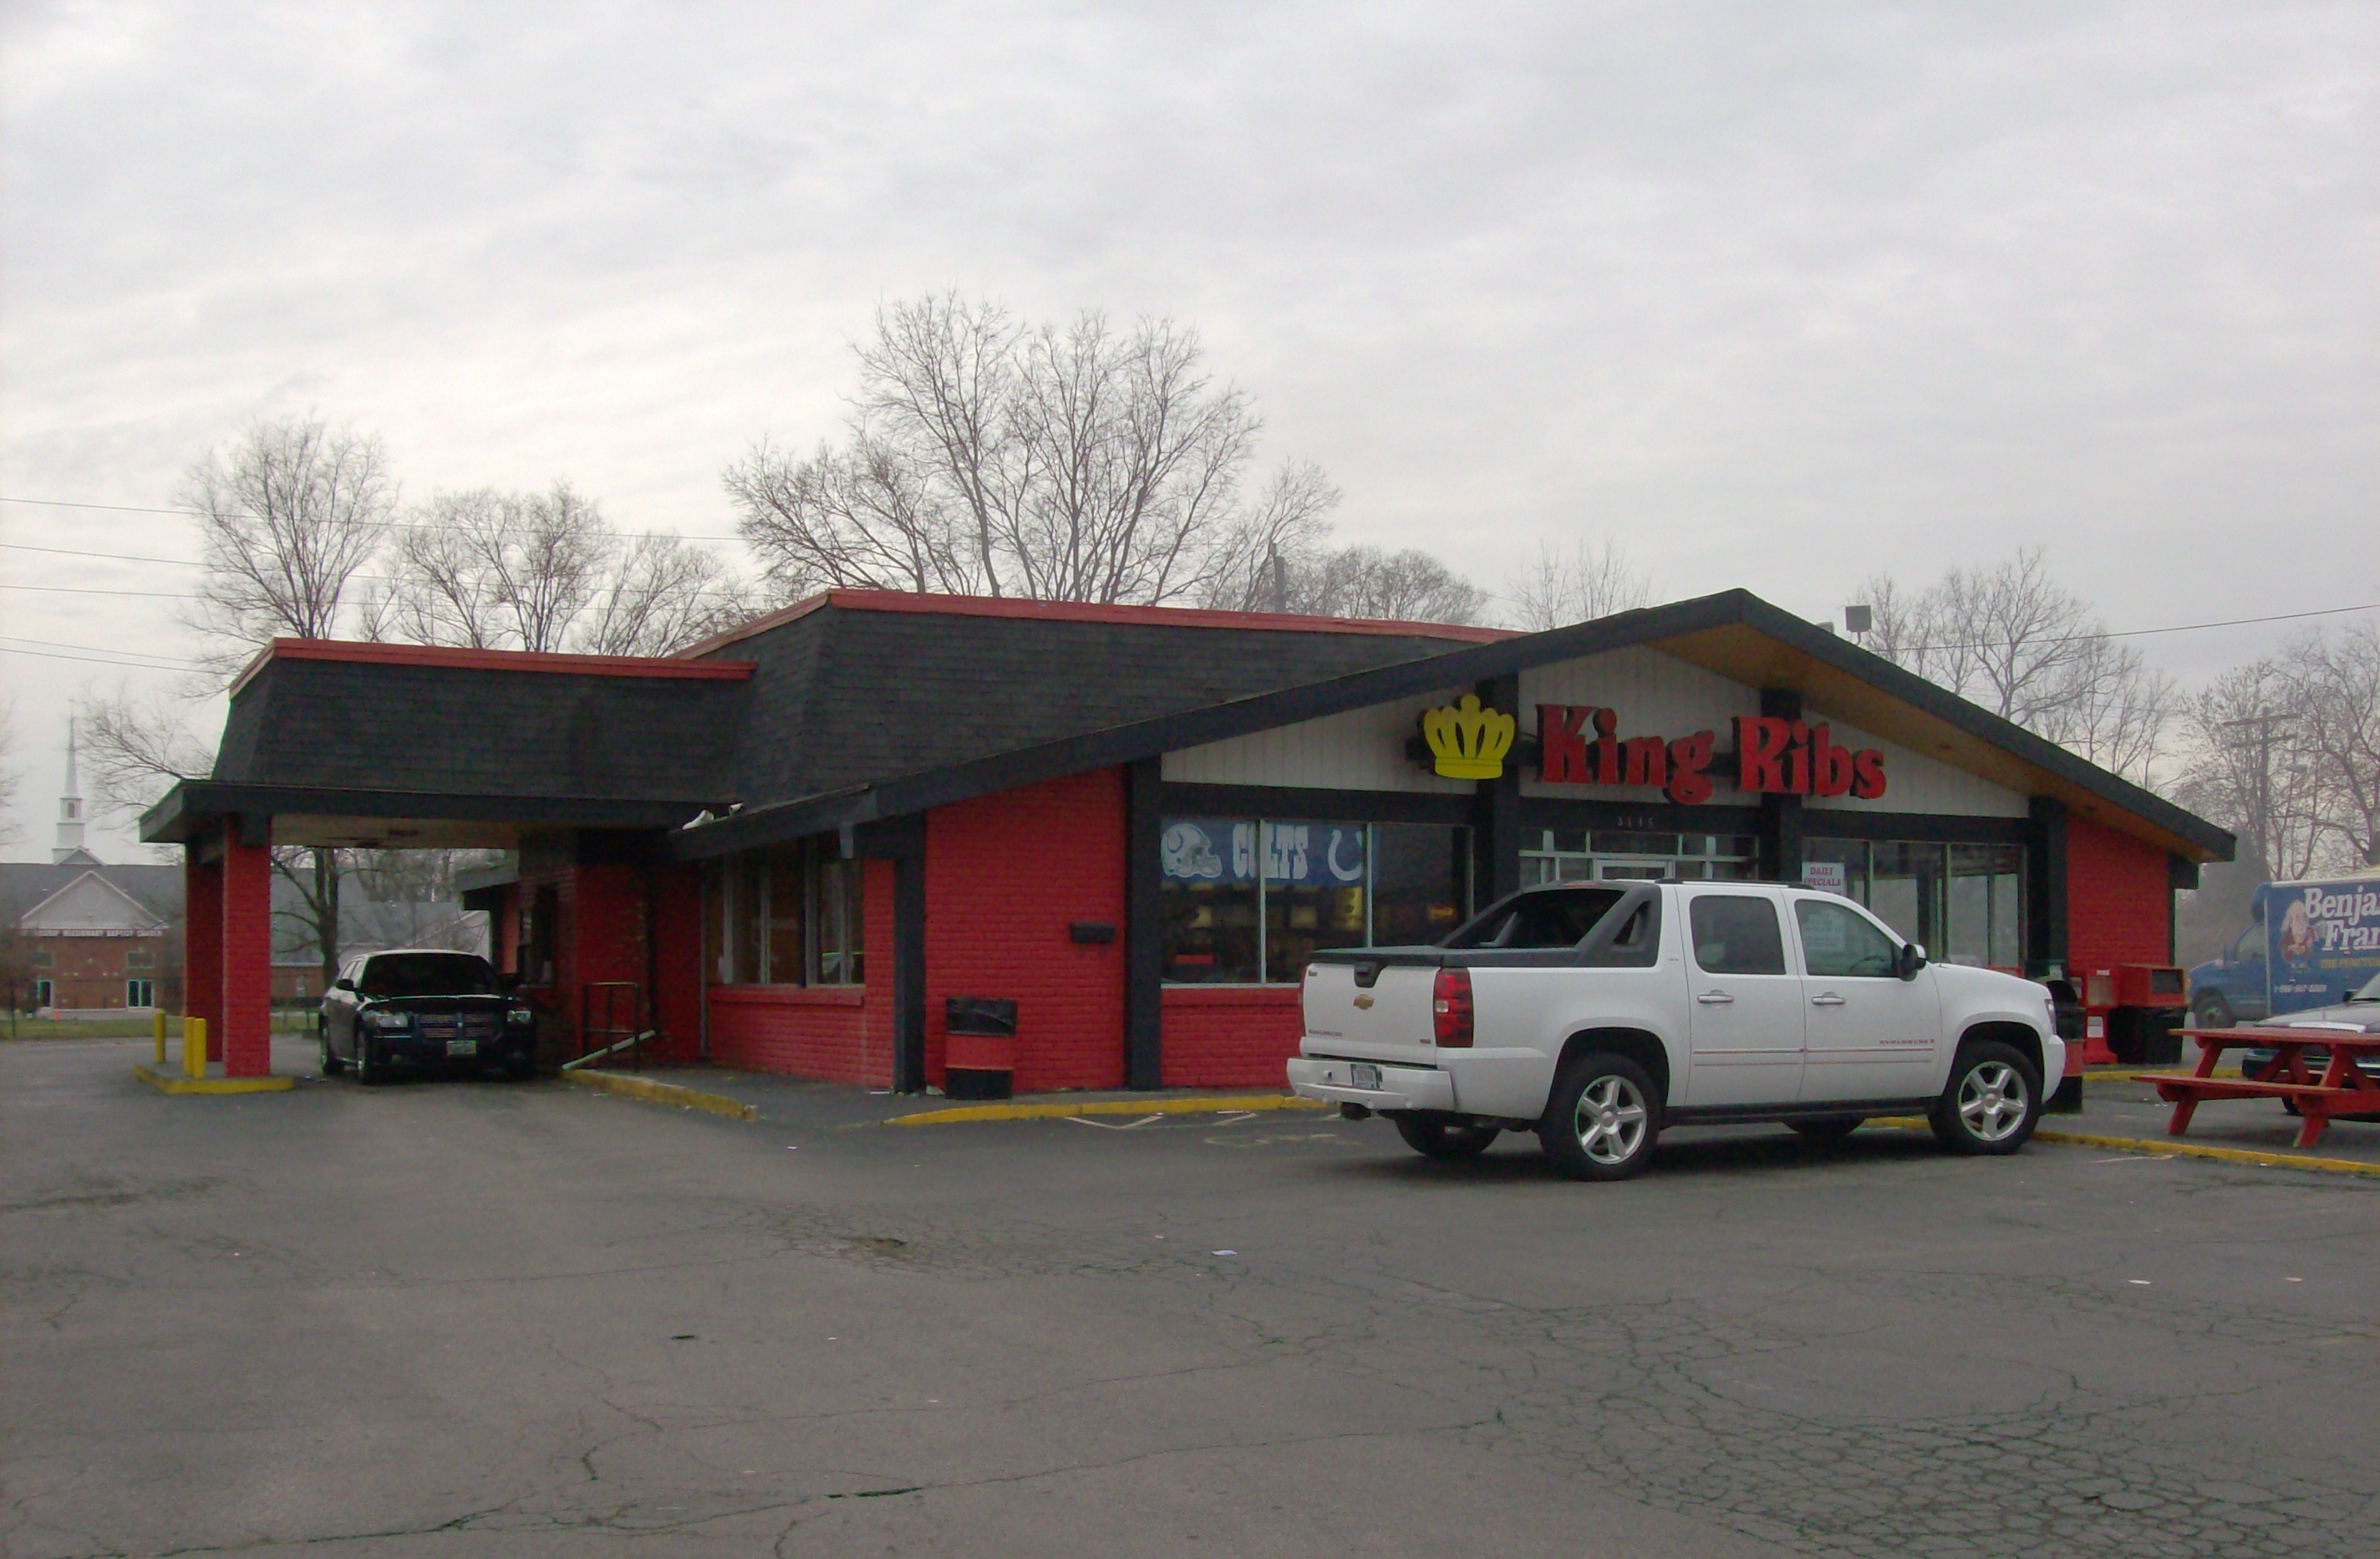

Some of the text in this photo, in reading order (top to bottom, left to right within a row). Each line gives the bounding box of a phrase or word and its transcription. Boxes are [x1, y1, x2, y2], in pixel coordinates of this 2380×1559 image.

[1537, 704, 1886, 805] King Ribs
[1233, 823, 1309, 879] COLTS
[1810, 866, 1833, 875] DAILY
[1804, 878, 1842, 886] SPECIALS
[2304, 885, 2380, 925] Benja
